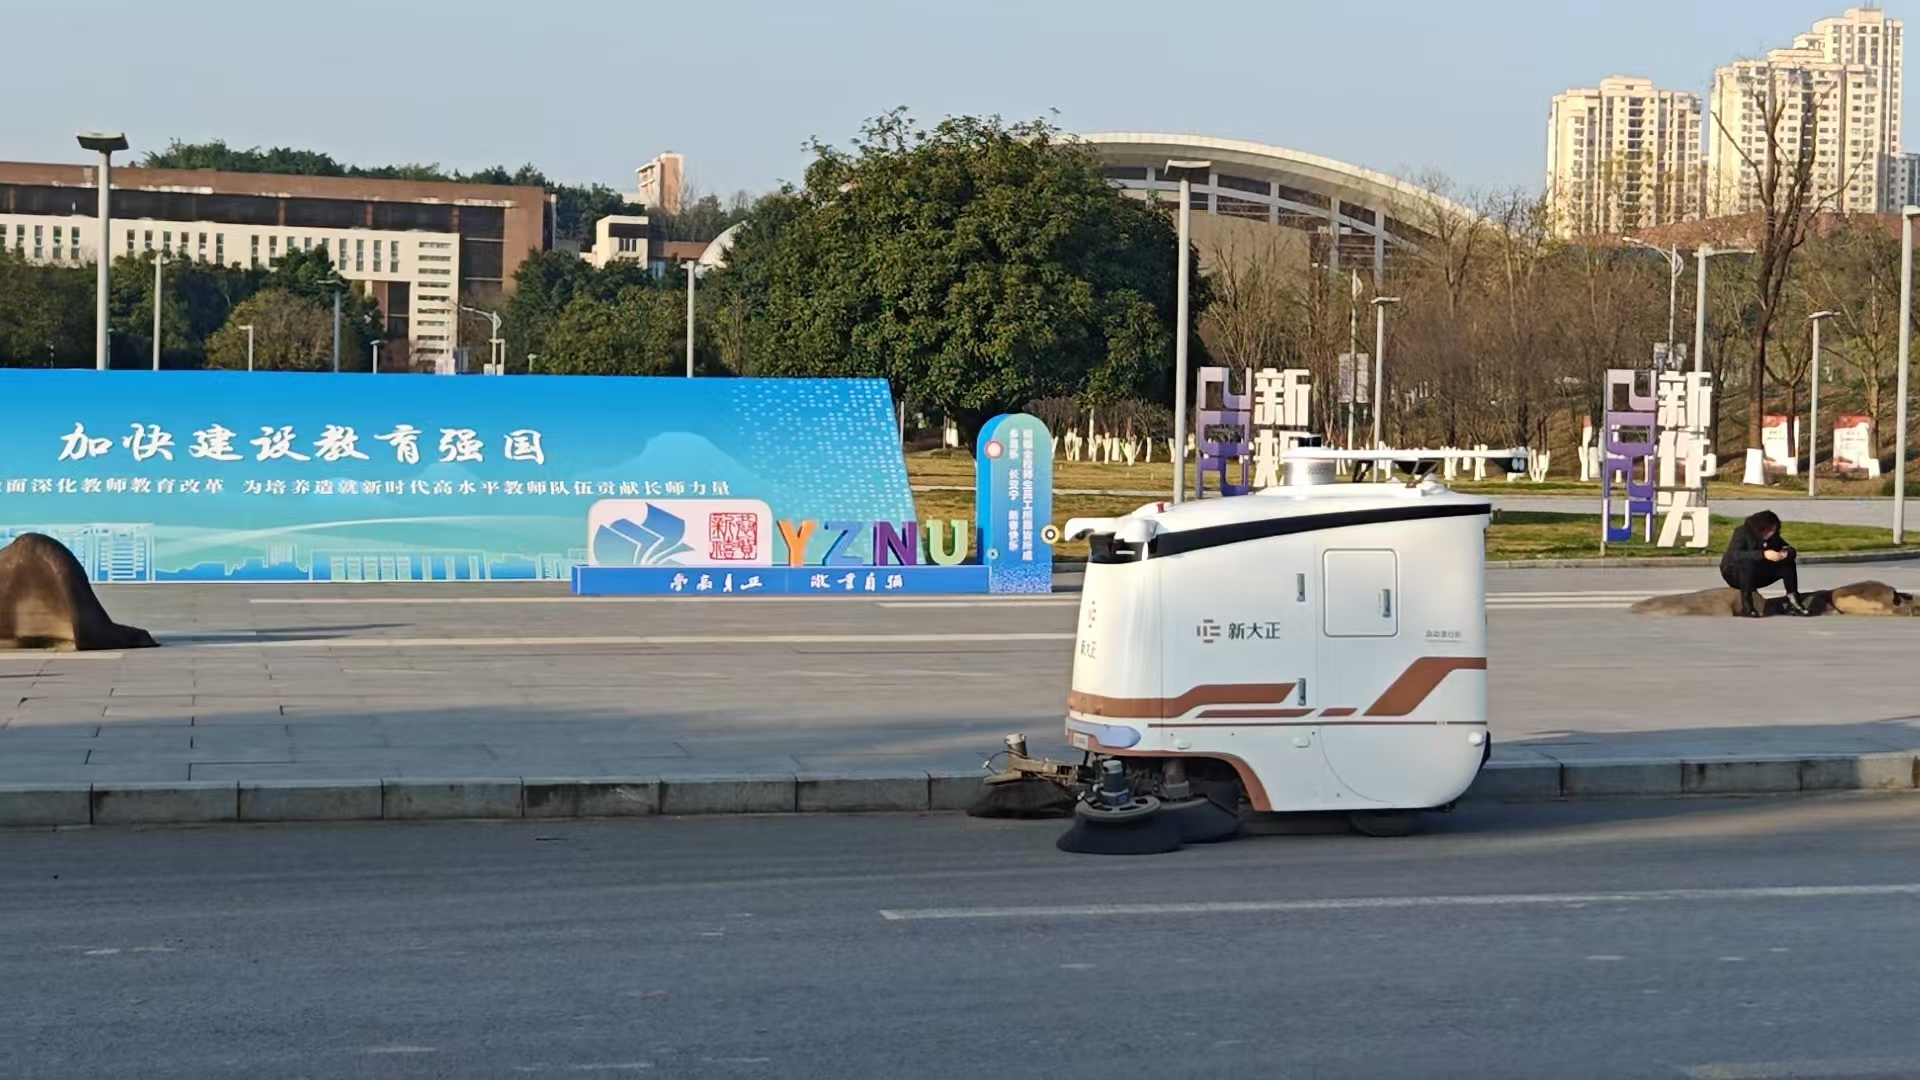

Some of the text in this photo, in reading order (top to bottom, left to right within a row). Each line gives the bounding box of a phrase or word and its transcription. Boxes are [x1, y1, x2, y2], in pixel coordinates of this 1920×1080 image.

[58, 422, 546, 465] 加快建设教育强国
[0, 477, 730, 496] 面深化教师教育改革 为培养造就新时代高水平教师队伍贡献长师力量
[776, 519, 969, 567] YZNU
[1228, 621, 1281, 640] 新大正
